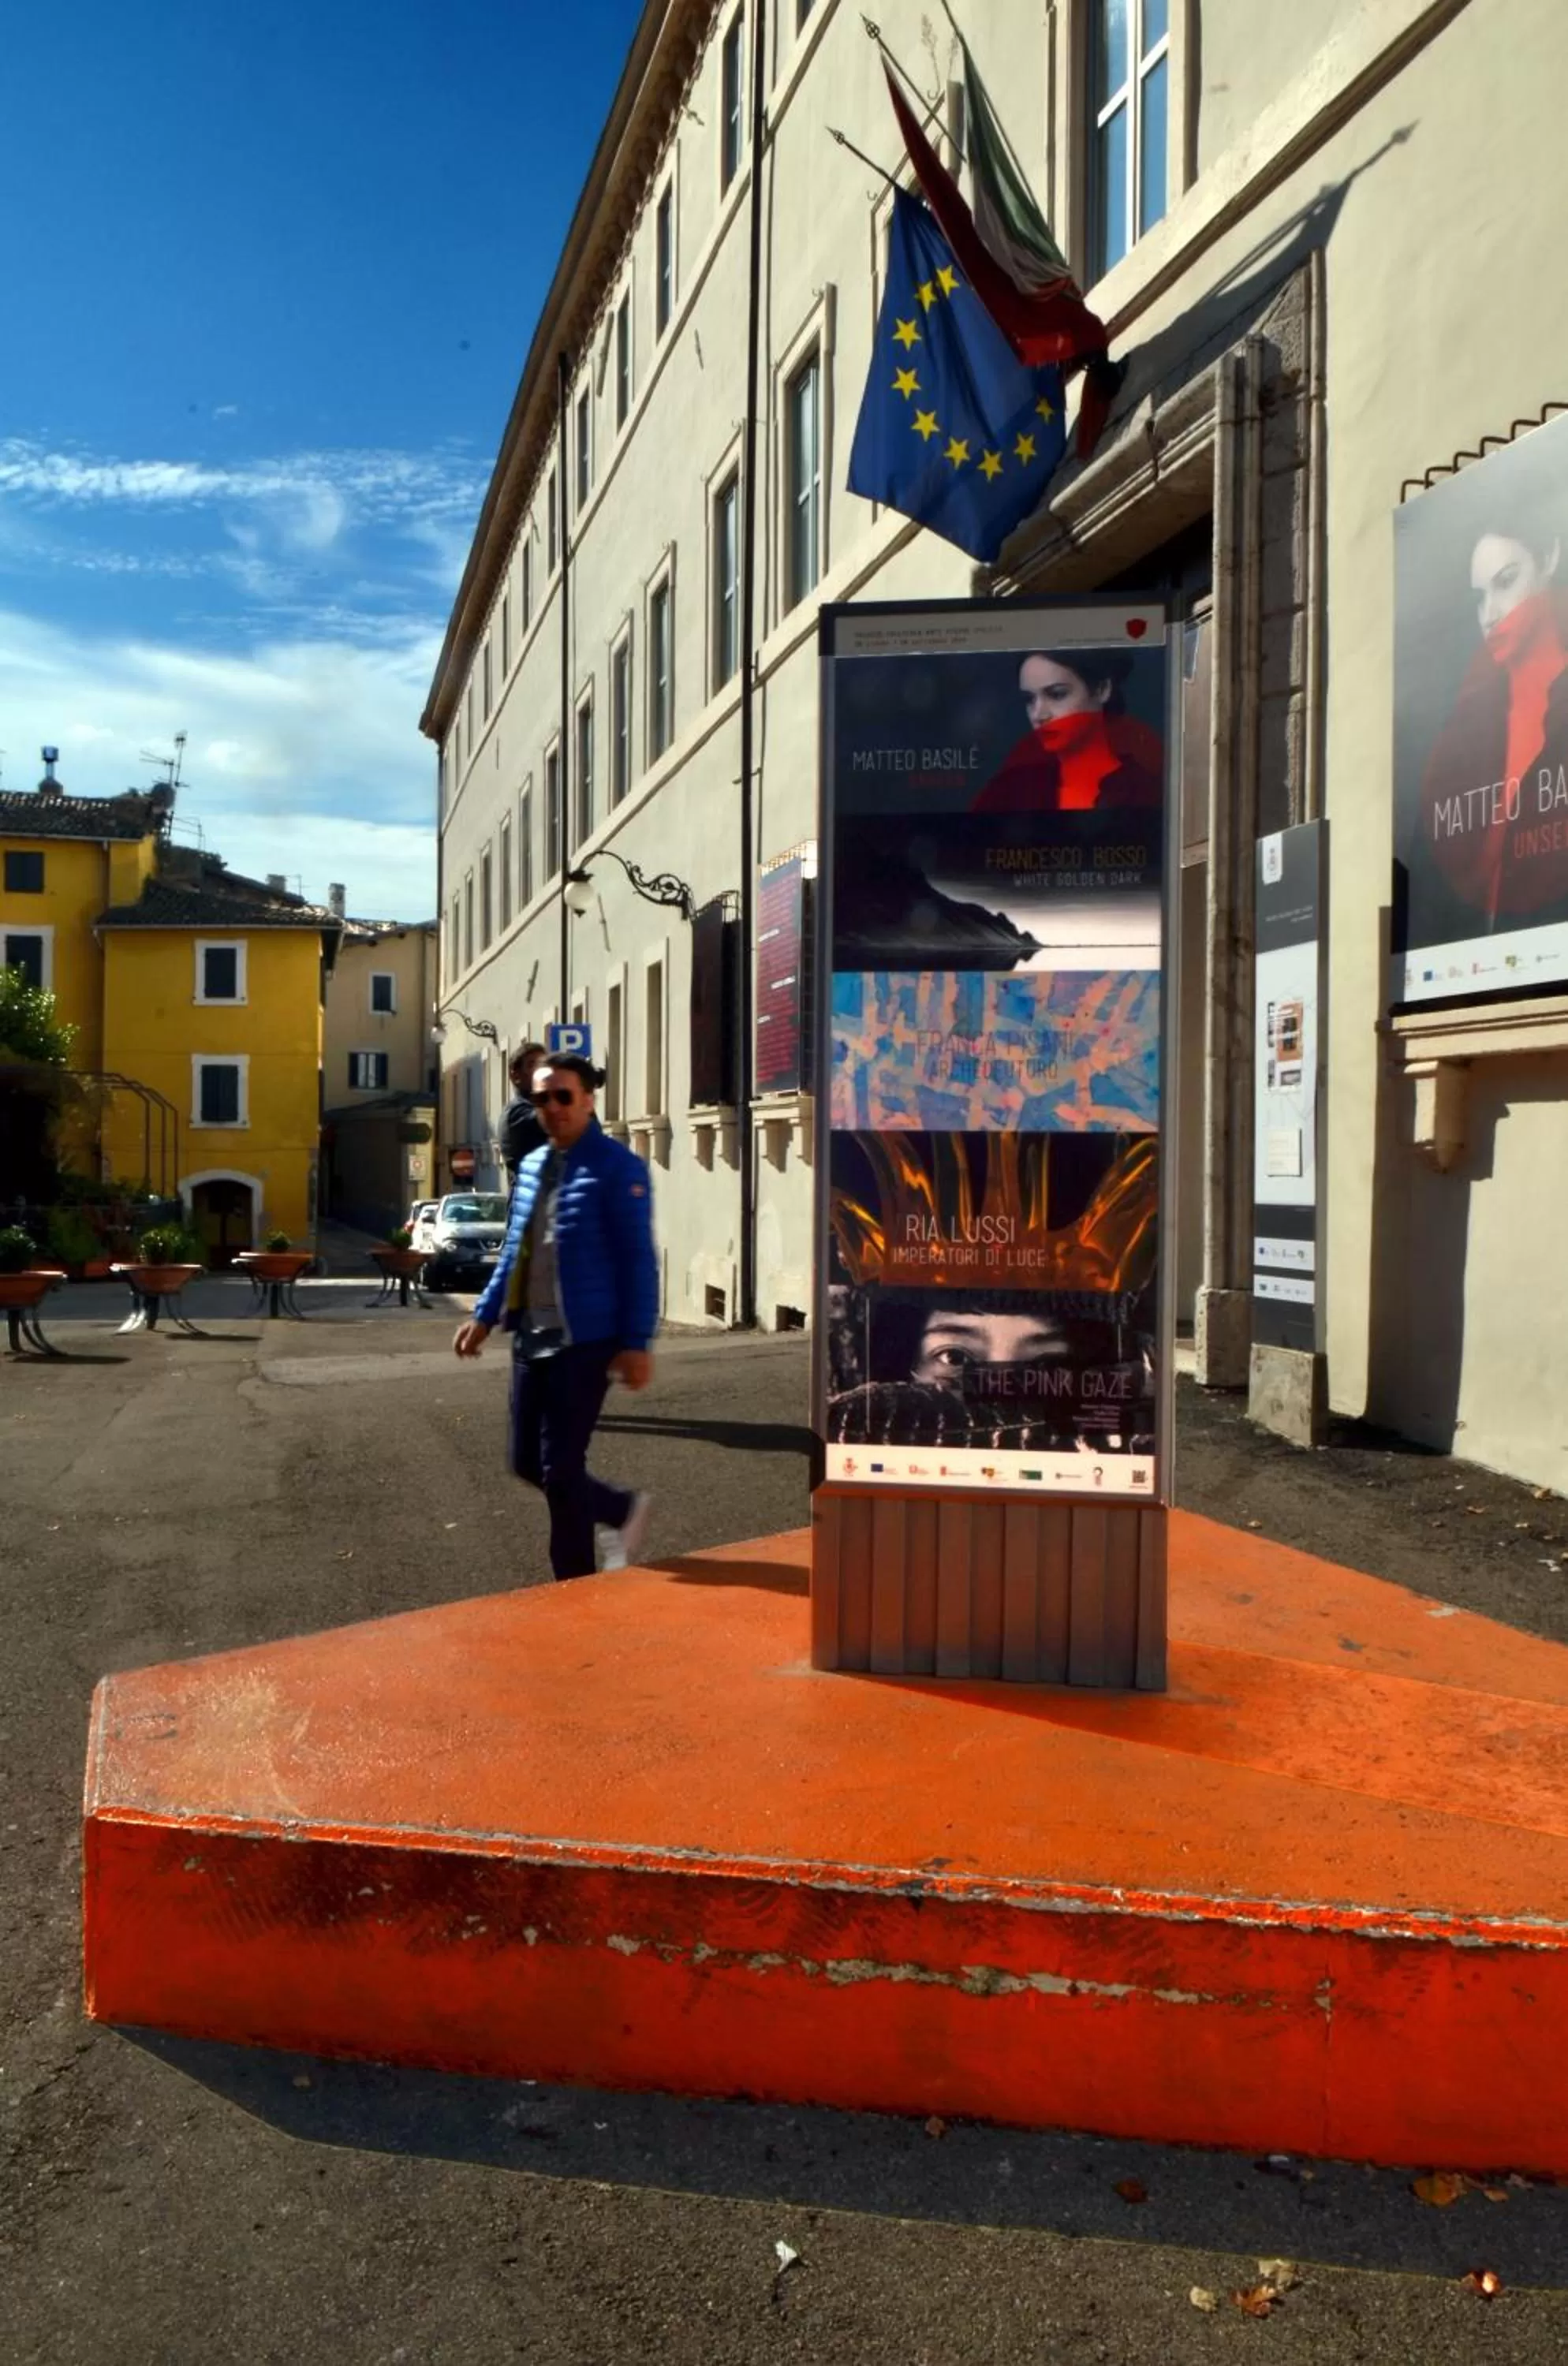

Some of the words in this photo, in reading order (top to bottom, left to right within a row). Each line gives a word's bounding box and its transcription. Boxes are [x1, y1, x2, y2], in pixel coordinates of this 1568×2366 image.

[853, 748, 916, 771] MATTEO
[1434, 776, 1521, 841] MATTEO
[1514, 821, 1568, 859] UNSE
[985, 846, 1083, 870] FRANCESCO
[1093, 845, 1148, 868] BOSSO
[1013, 871, 1050, 887] WHITE
[1056, 871, 1105, 886] GOLDEN
[1110, 870, 1143, 885] DARK
[558, 1029, 584, 1051] P
[917, 1030, 997, 1057] FRANCA
[905, 1214, 939, 1241] RIA
[951, 1215, 1016, 1245] LUSSI
[893, 1246, 979, 1265] IMPERATORI
[985, 1248, 1000, 1266] DI
[1007, 1248, 1046, 1267] LUCE
[975, 1368, 1017, 1396] THE
[1023, 1367, 1074, 1398] PINK
[1081, 1370, 1133, 1400] GAZE
